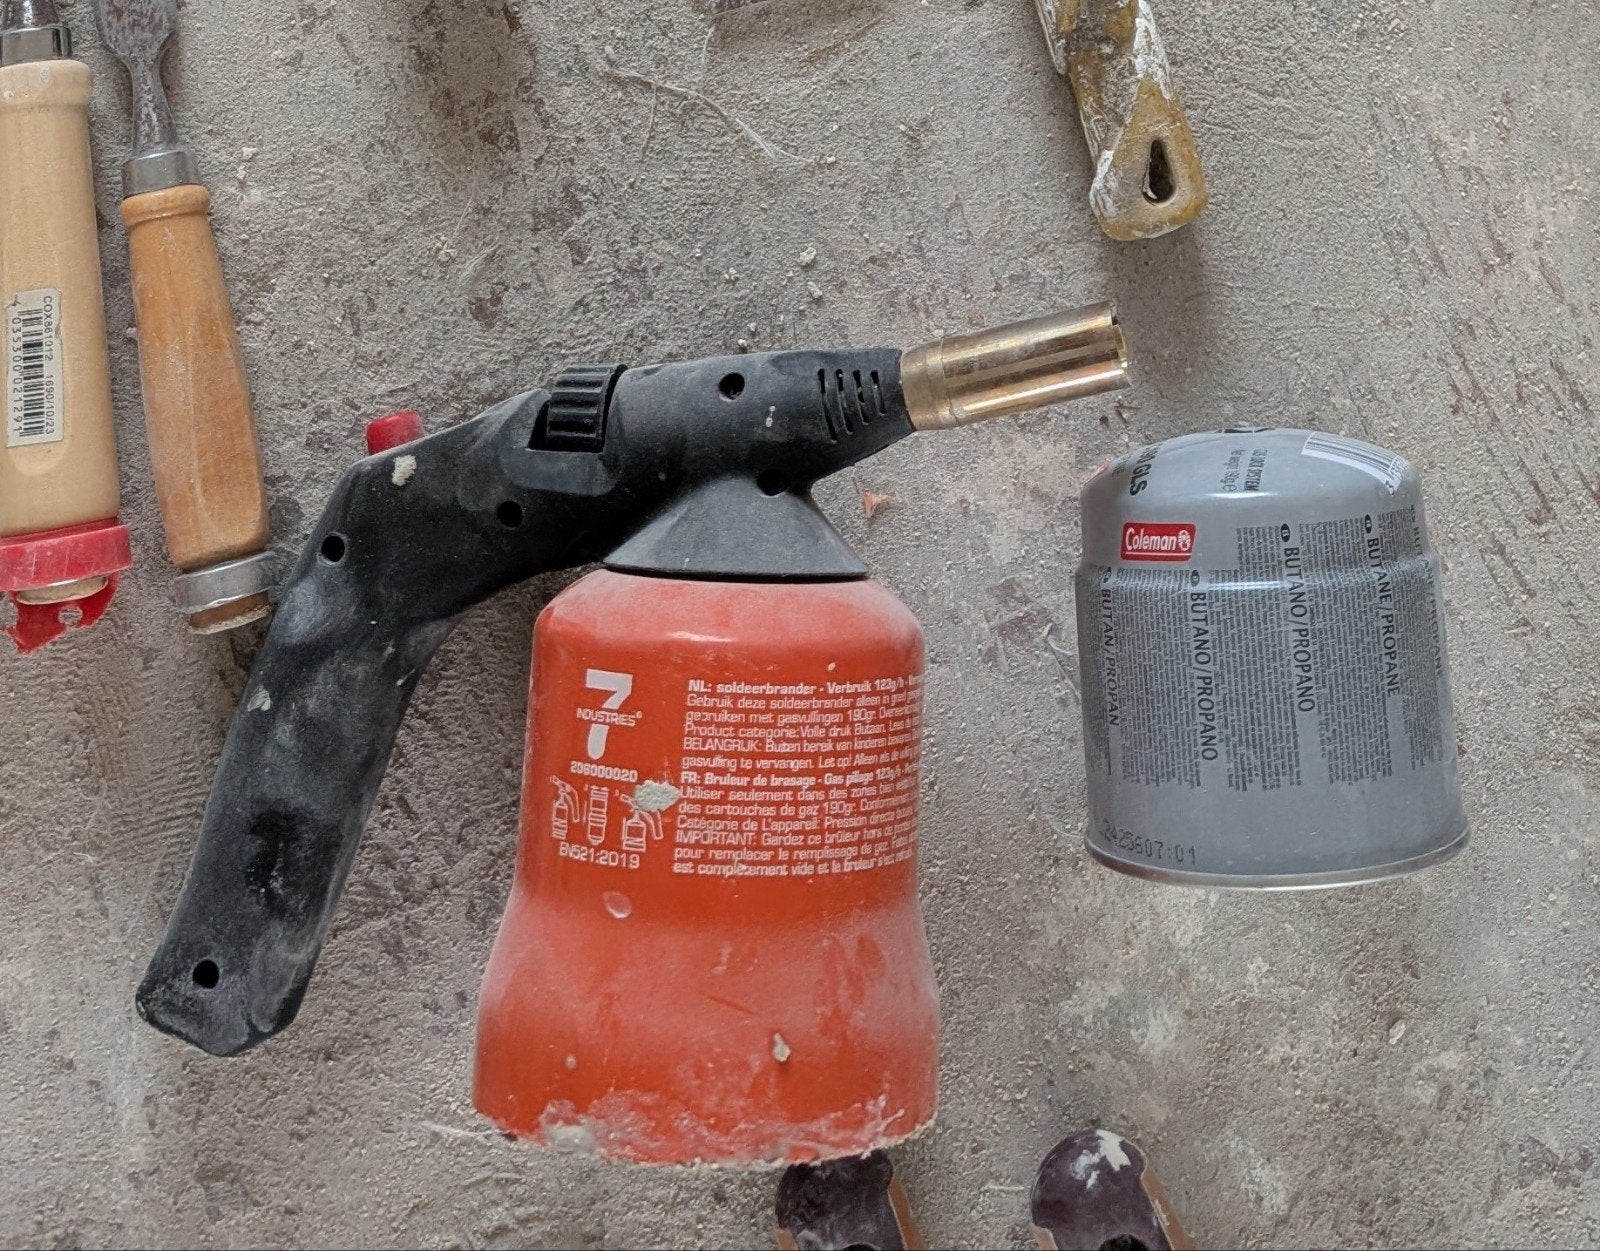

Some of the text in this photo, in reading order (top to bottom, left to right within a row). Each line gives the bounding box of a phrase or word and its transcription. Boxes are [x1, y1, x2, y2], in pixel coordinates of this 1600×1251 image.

[43, 295, 55, 434] COX861012 1690/10/23
[1130, 463, 1152, 496] GLS
[1125, 527, 1177, 551] Coleman
[1366, 538, 1400, 698] BUTANE/PROPANE
[1283, 547, 1316, 712] BUTANO/PROPANO
[1100, 588, 1120, 726] BUTAN/PROPAN
[1190, 592, 1219, 760] BUTANO/PROPANO
[688, 679, 712, 692] NL:
[716, 681, 817, 694] soldeerbrander
[826, 681, 872, 694] Verbruik
[686, 693, 734, 708] Gebruik
[737, 696, 765, 709] deze
[770, 696, 853, 709] soldeerbrander
[585, 669, 633, 760] 7
[685, 709, 745, 724] gebruiken
[749, 711, 774, 723] met
[777, 710, 844, 726] gasvullingen
[684, 722, 734, 737] Product
[829, 724, 851, 737] druk
[765, 739, 800, 752] Buiten
[803, 739, 834, 752] bereik
[836, 741, 852, 751] van
[681, 755, 737, 771] gasvulling
[740, 757, 752, 769] te
[756, 758, 814, 771] vervangen.
[818, 756, 835, 768] Let
[680, 771, 701, 784] FR:
[704, 772, 750, 786] Bruleur
[753, 774, 767, 786] de
[770, 774, 816, 788] brasage
[824, 773, 844, 785] Gas
[680, 786, 724, 799] Utiliser
[728, 788, 793, 801] seulement
[797, 787, 825, 800] dans
[829, 787, 847, 799] des
[678, 801, 701, 813] des
[705, 804, 776, 816] cartouches
[781, 803, 795, 816] de
[799, 805, 819, 818] gaz
[742, 817, 758, 831] de
[825, 816, 867, 828] Pression
[762, 833, 804, 846] Gardez
[807, 834, 821, 845] ce
[559, 841, 640, 869] EN521:2019
[674, 847, 704, 861] pour
[709, 847, 774, 861] remplacer
[778, 847, 789, 860] le
[794, 846, 858, 862] remplissage
[861, 843, 872, 855] de
[673, 862, 694, 873] est
[791, 862, 814, 876] vide
[817, 862, 829, 874] et
[832, 860, 841, 874] le
